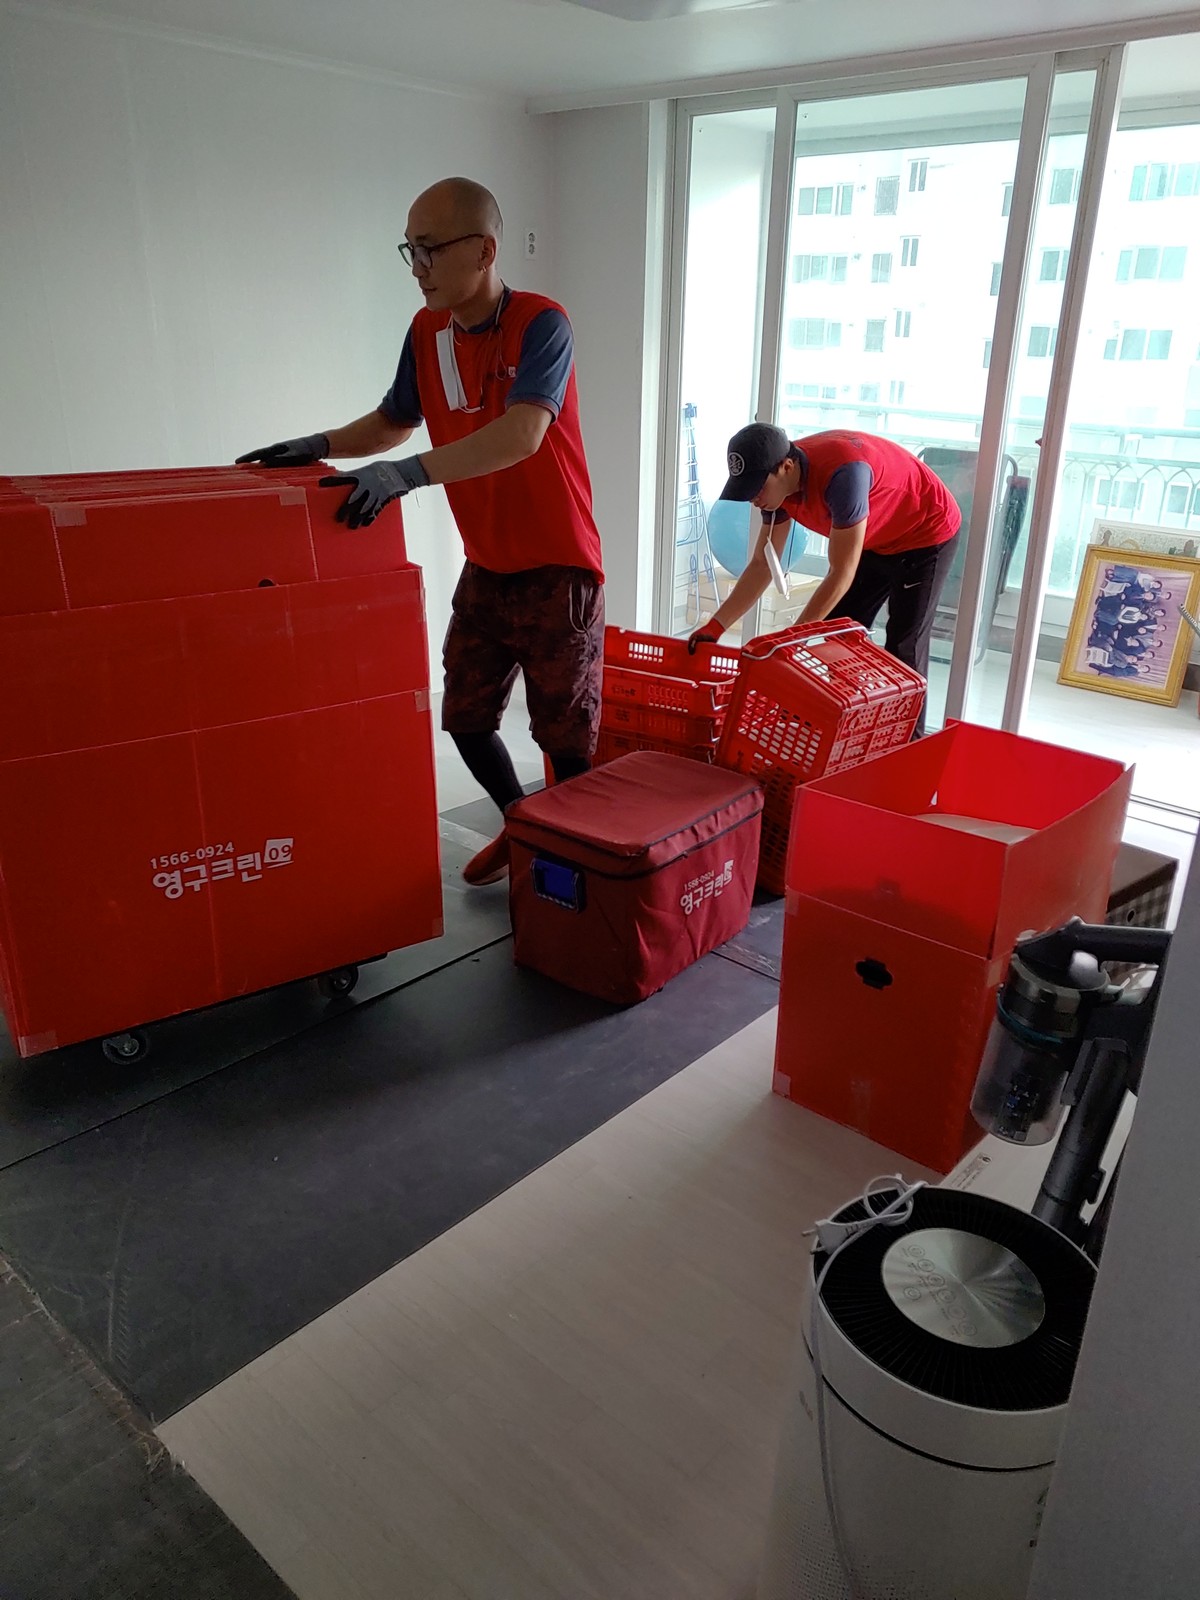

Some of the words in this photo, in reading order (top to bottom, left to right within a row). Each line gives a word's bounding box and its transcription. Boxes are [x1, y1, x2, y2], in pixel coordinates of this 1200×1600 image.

[150, 841, 235, 870] 1566-0924
[152, 852, 263, 899] 영구크린
[266, 841, 293, 862] 09
[680, 873, 723, 915] 영구크린
